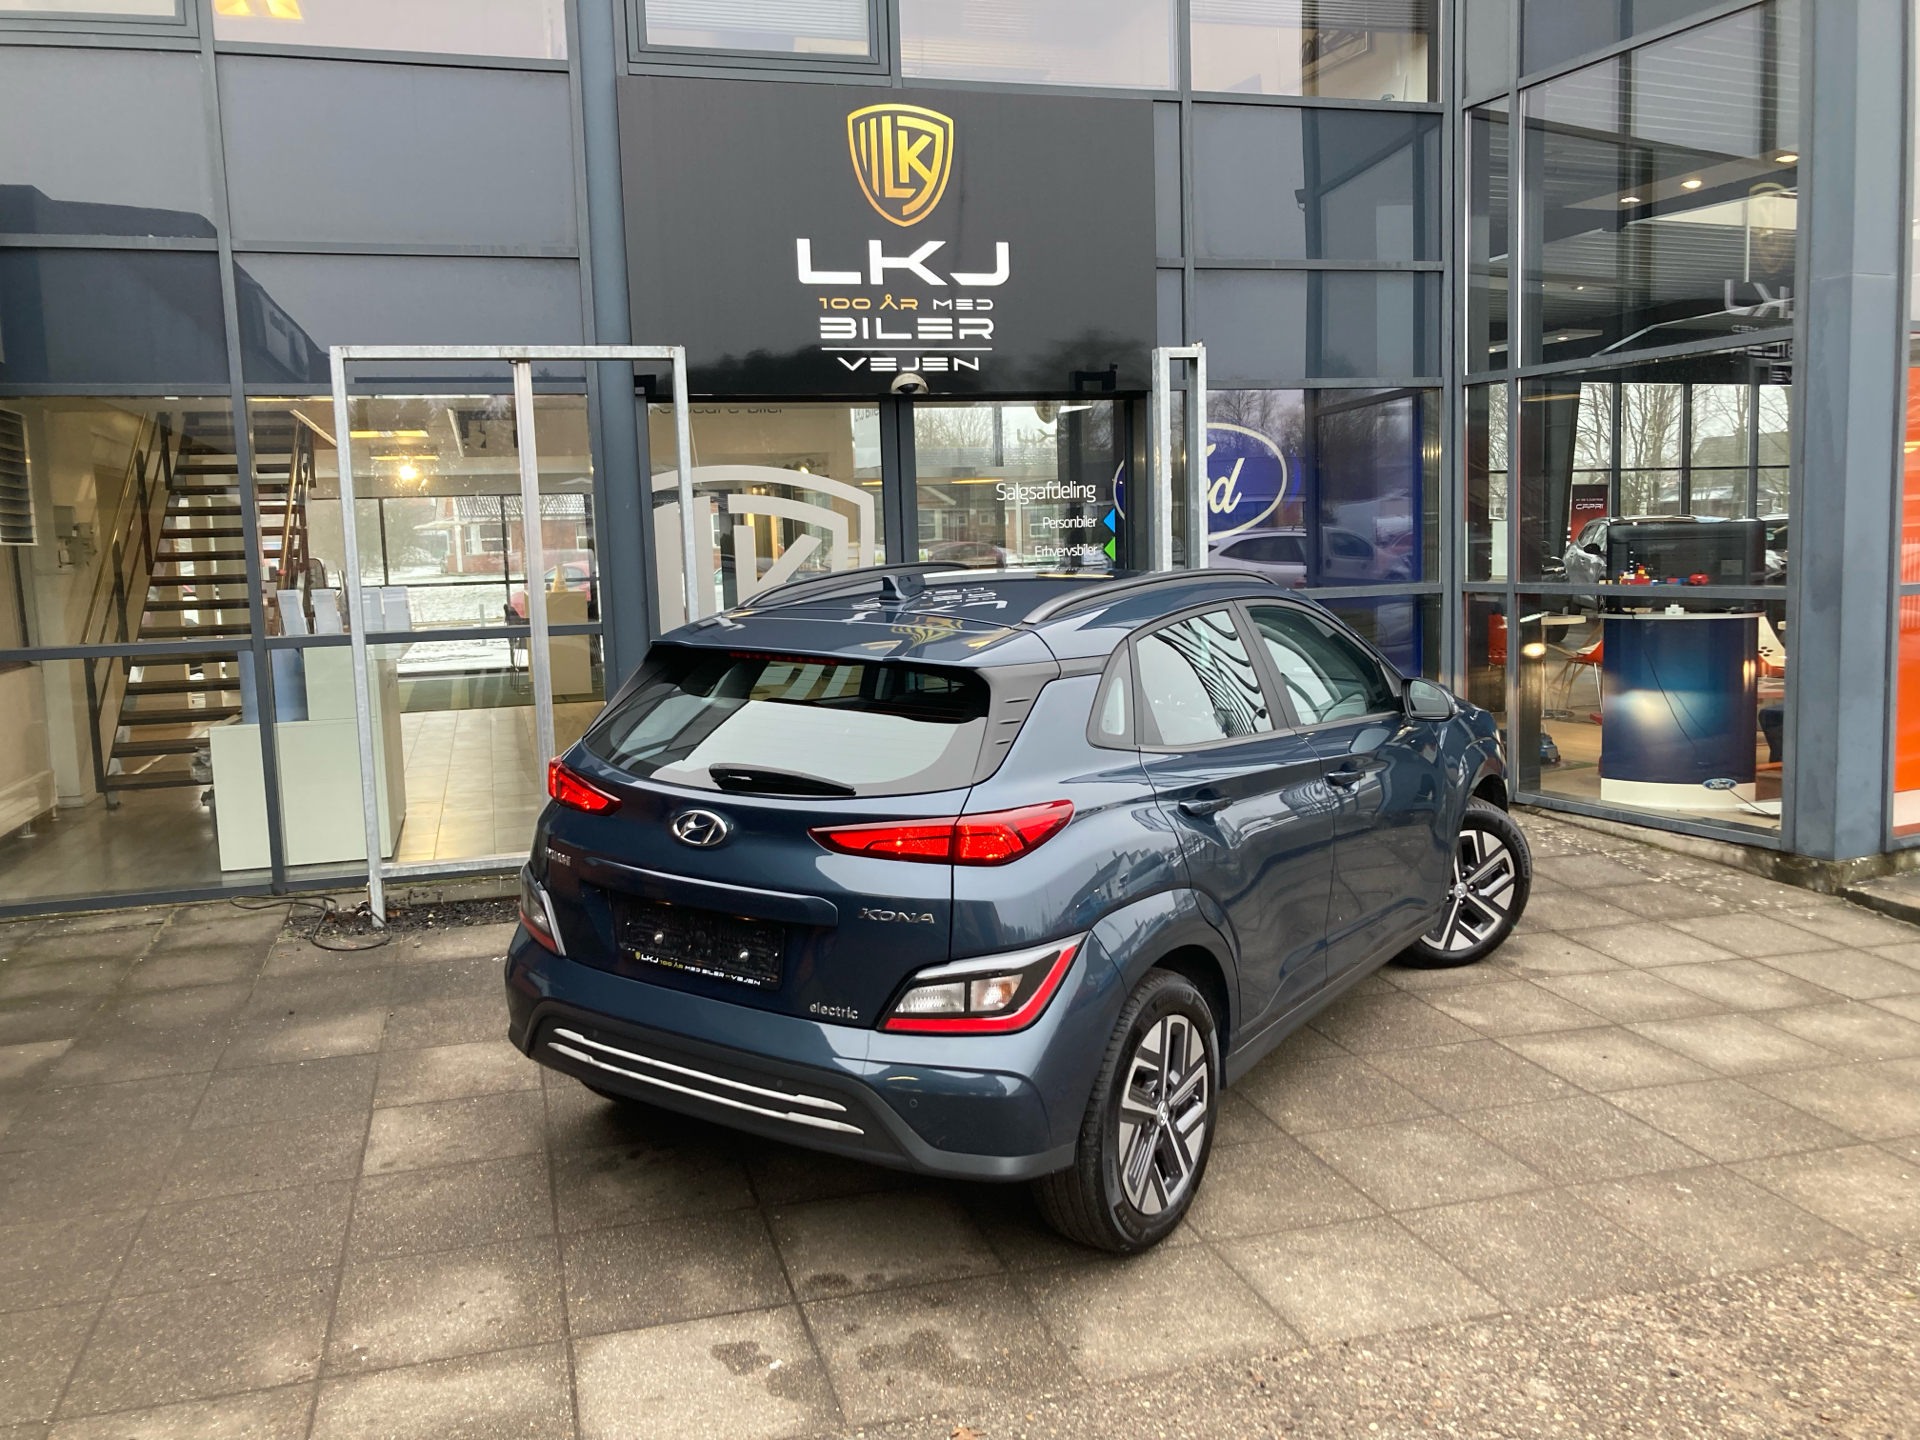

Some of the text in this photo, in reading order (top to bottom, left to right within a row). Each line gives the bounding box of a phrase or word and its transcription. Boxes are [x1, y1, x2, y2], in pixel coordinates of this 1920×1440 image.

[796, 238, 1010, 286] LKJ
[819, 293, 994, 310] 100 ÅR MED
[819, 316, 994, 340] BILER
[836, 356, 980, 372] VEJEN
[995, 480, 1097, 505] Salgsafdeling
[1042, 515, 1097, 529] Personbiler
[1034, 543, 1098, 558] Erhvervsbiler
[858, 907, 935, 924] KONA
[641, 953, 659, 964] LKJ
[731, 974, 761, 986] VEJEN
[809, 1002, 858, 1020] electric
